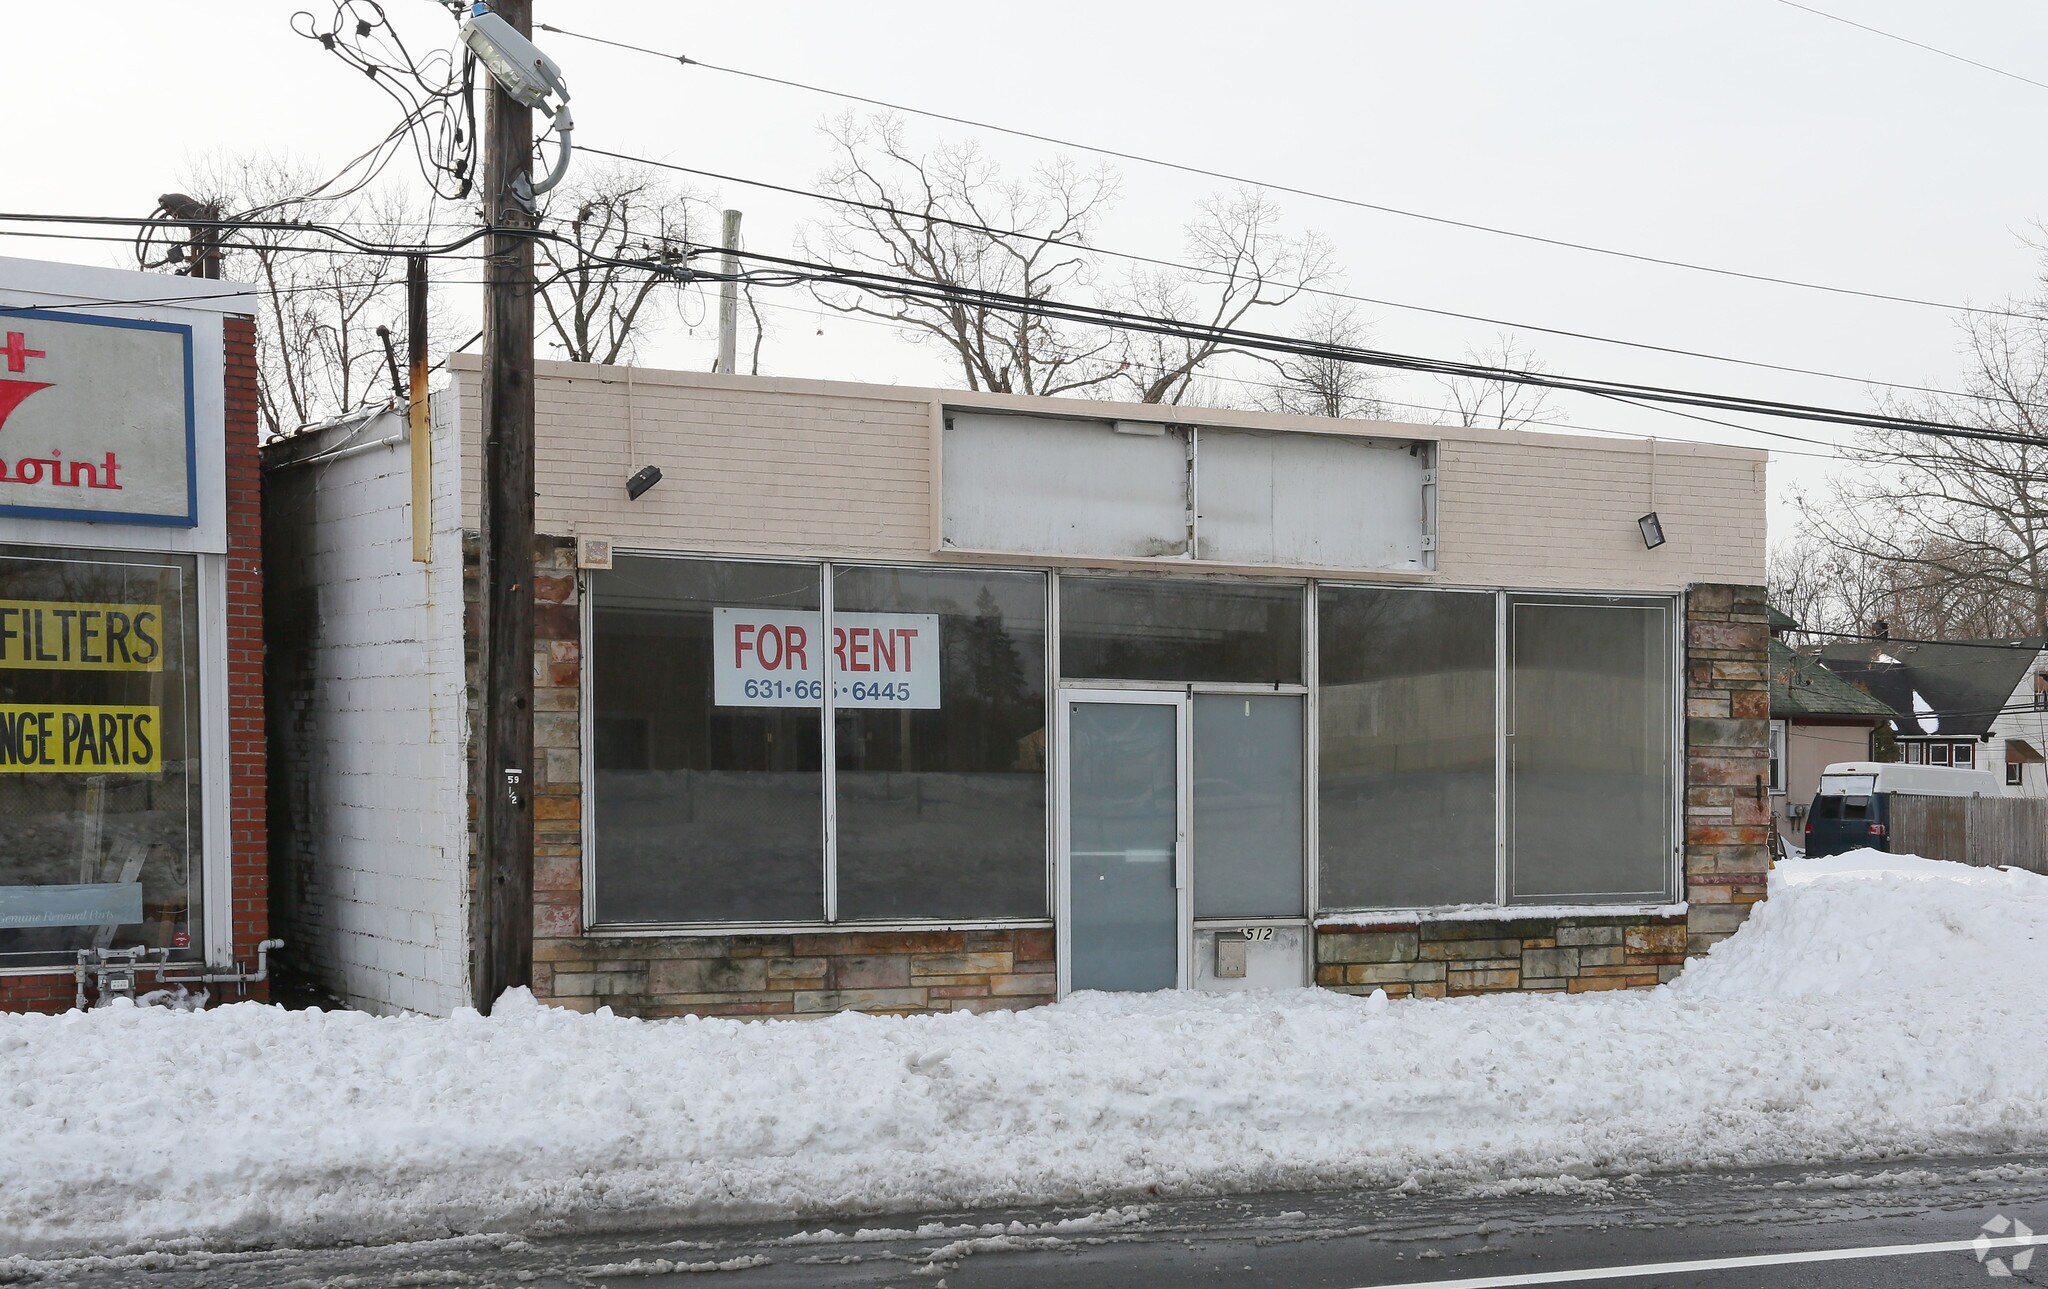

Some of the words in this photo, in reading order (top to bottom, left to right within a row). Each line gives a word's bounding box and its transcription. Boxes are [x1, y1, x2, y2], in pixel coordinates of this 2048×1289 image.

[0, 608, 159, 664] FILTERS
[735, 624, 807, 671] FOR
[834, 628, 918, 672] RENT
[62, 713, 153, 765] PARTS
[1241, 928, 1272, 940] 512
